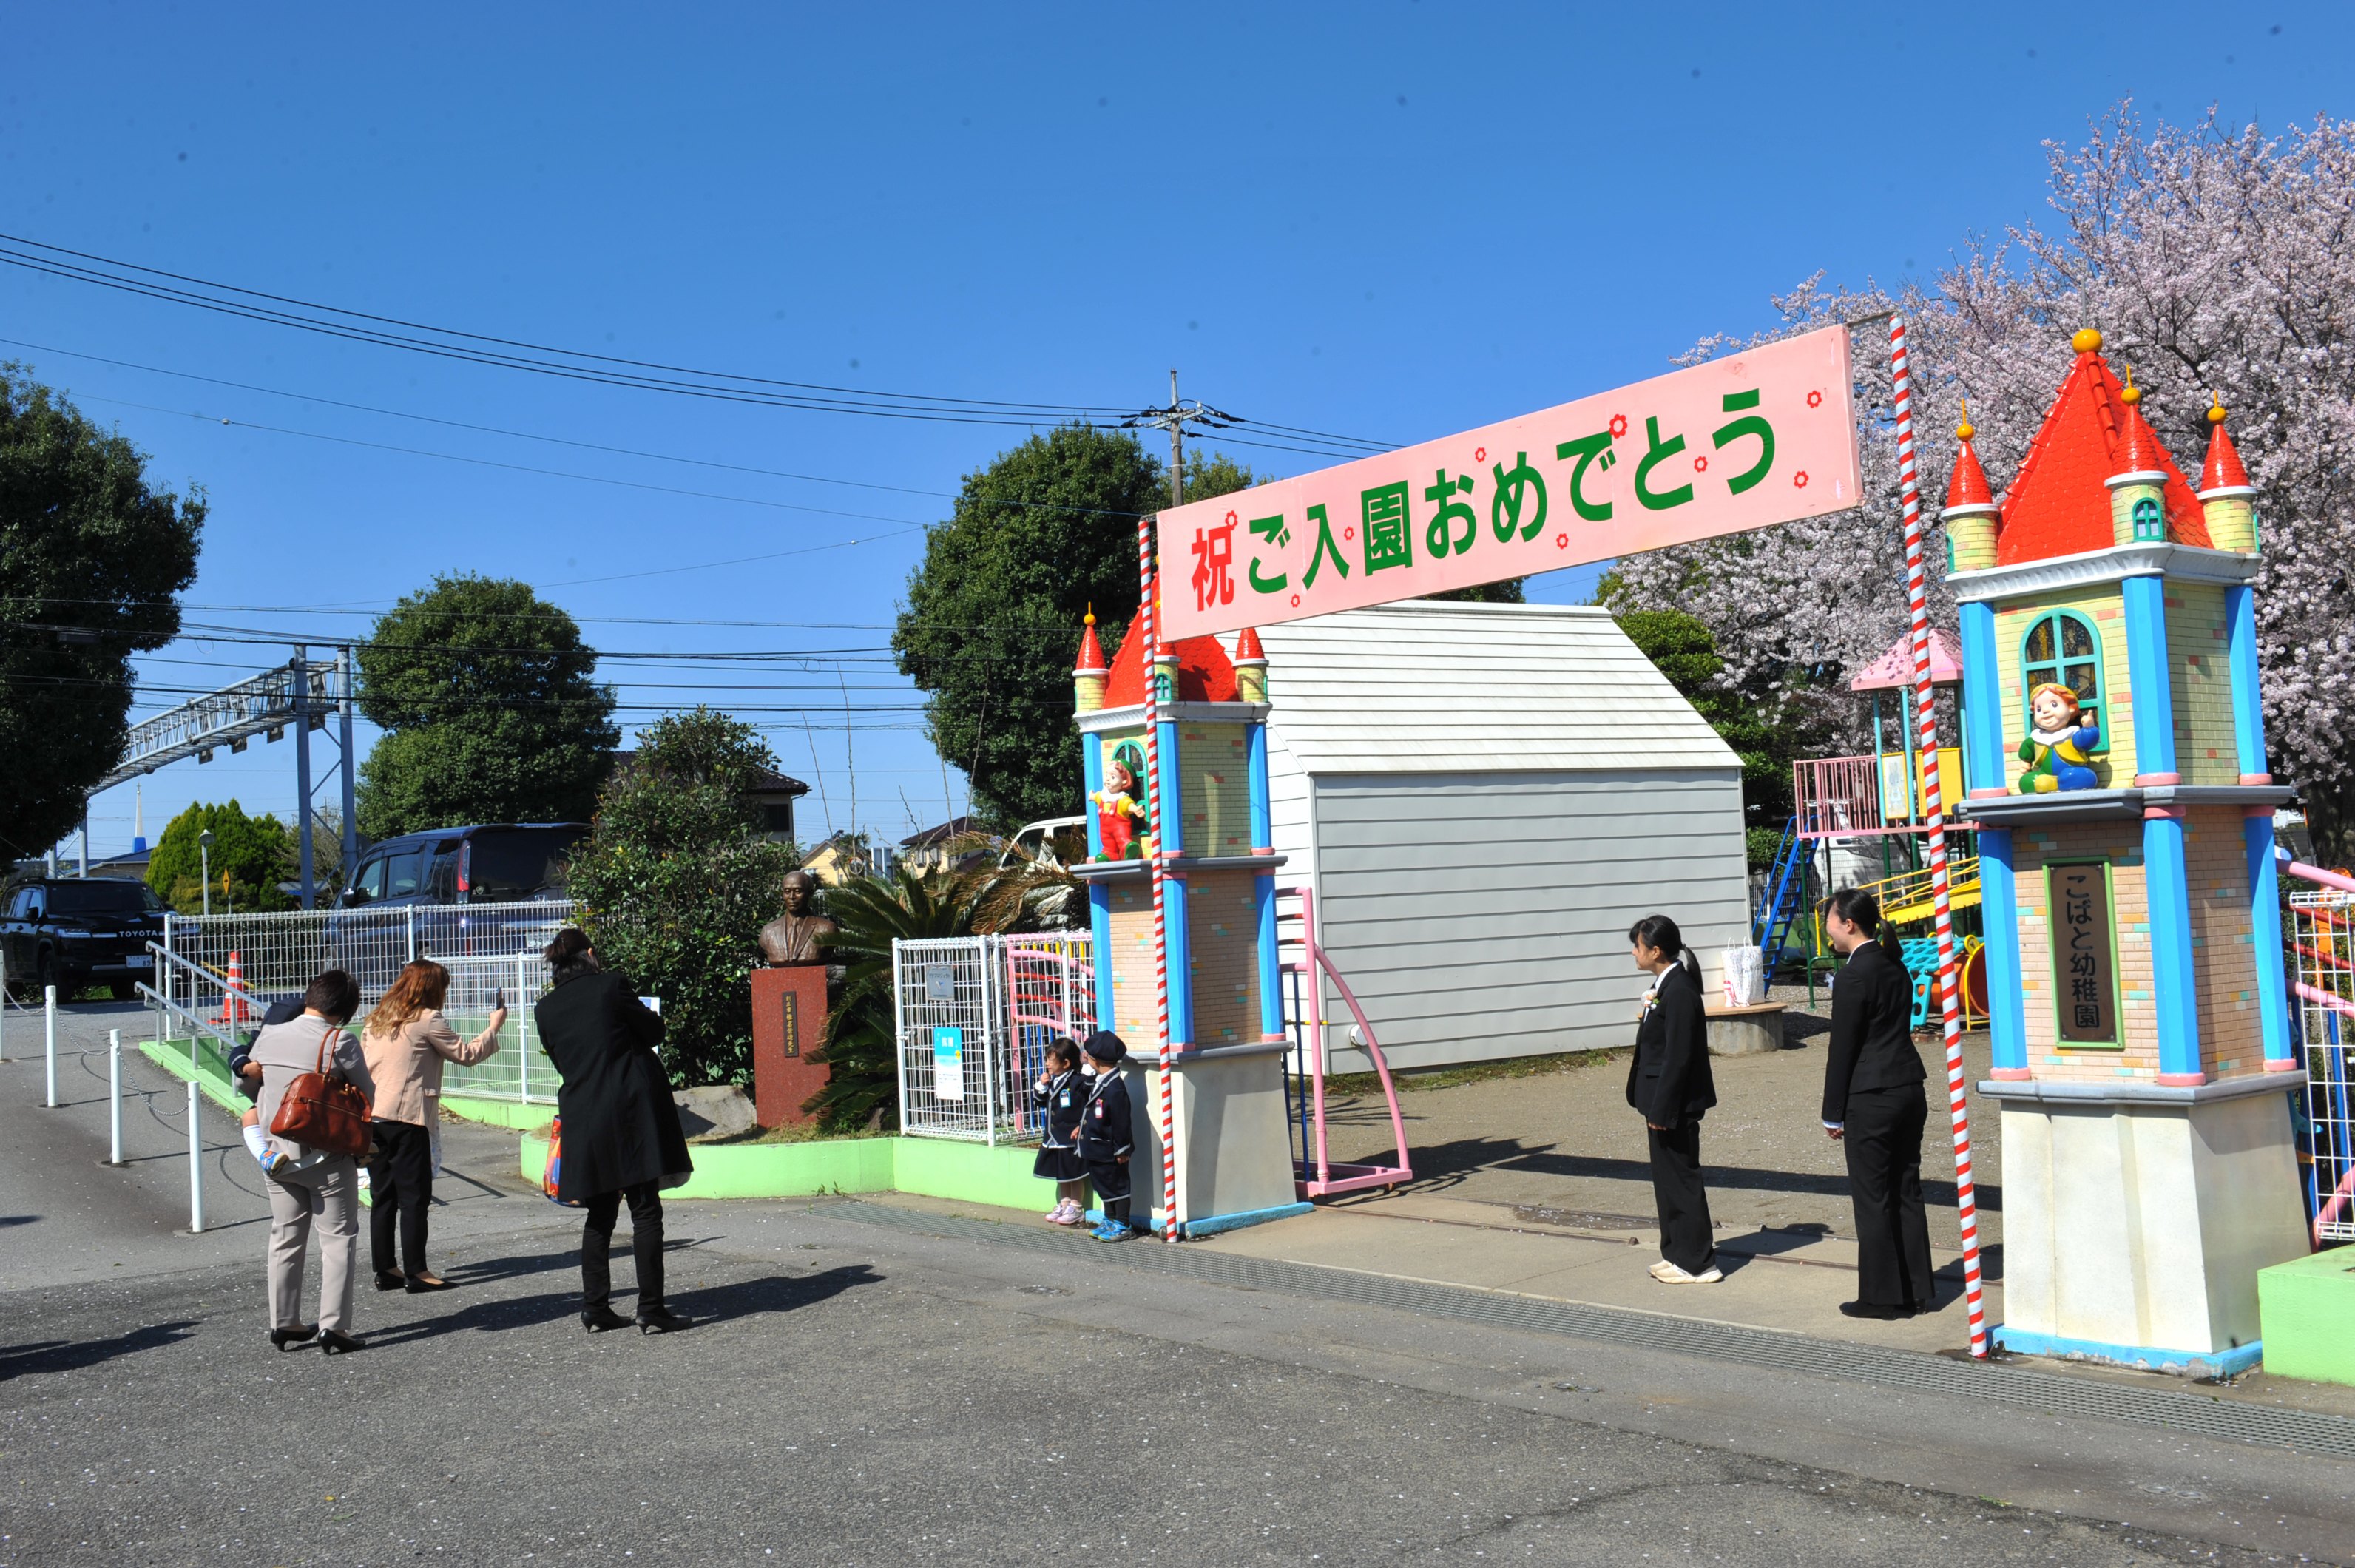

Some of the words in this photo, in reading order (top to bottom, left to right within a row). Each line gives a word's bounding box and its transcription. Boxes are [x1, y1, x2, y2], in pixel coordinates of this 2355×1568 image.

[1192, 388, 1775, 612] 祝ご入園おめでとう
[118, 930, 158, 938] TOYOTA
[2067, 875, 2100, 1029] こばと幼稚園
